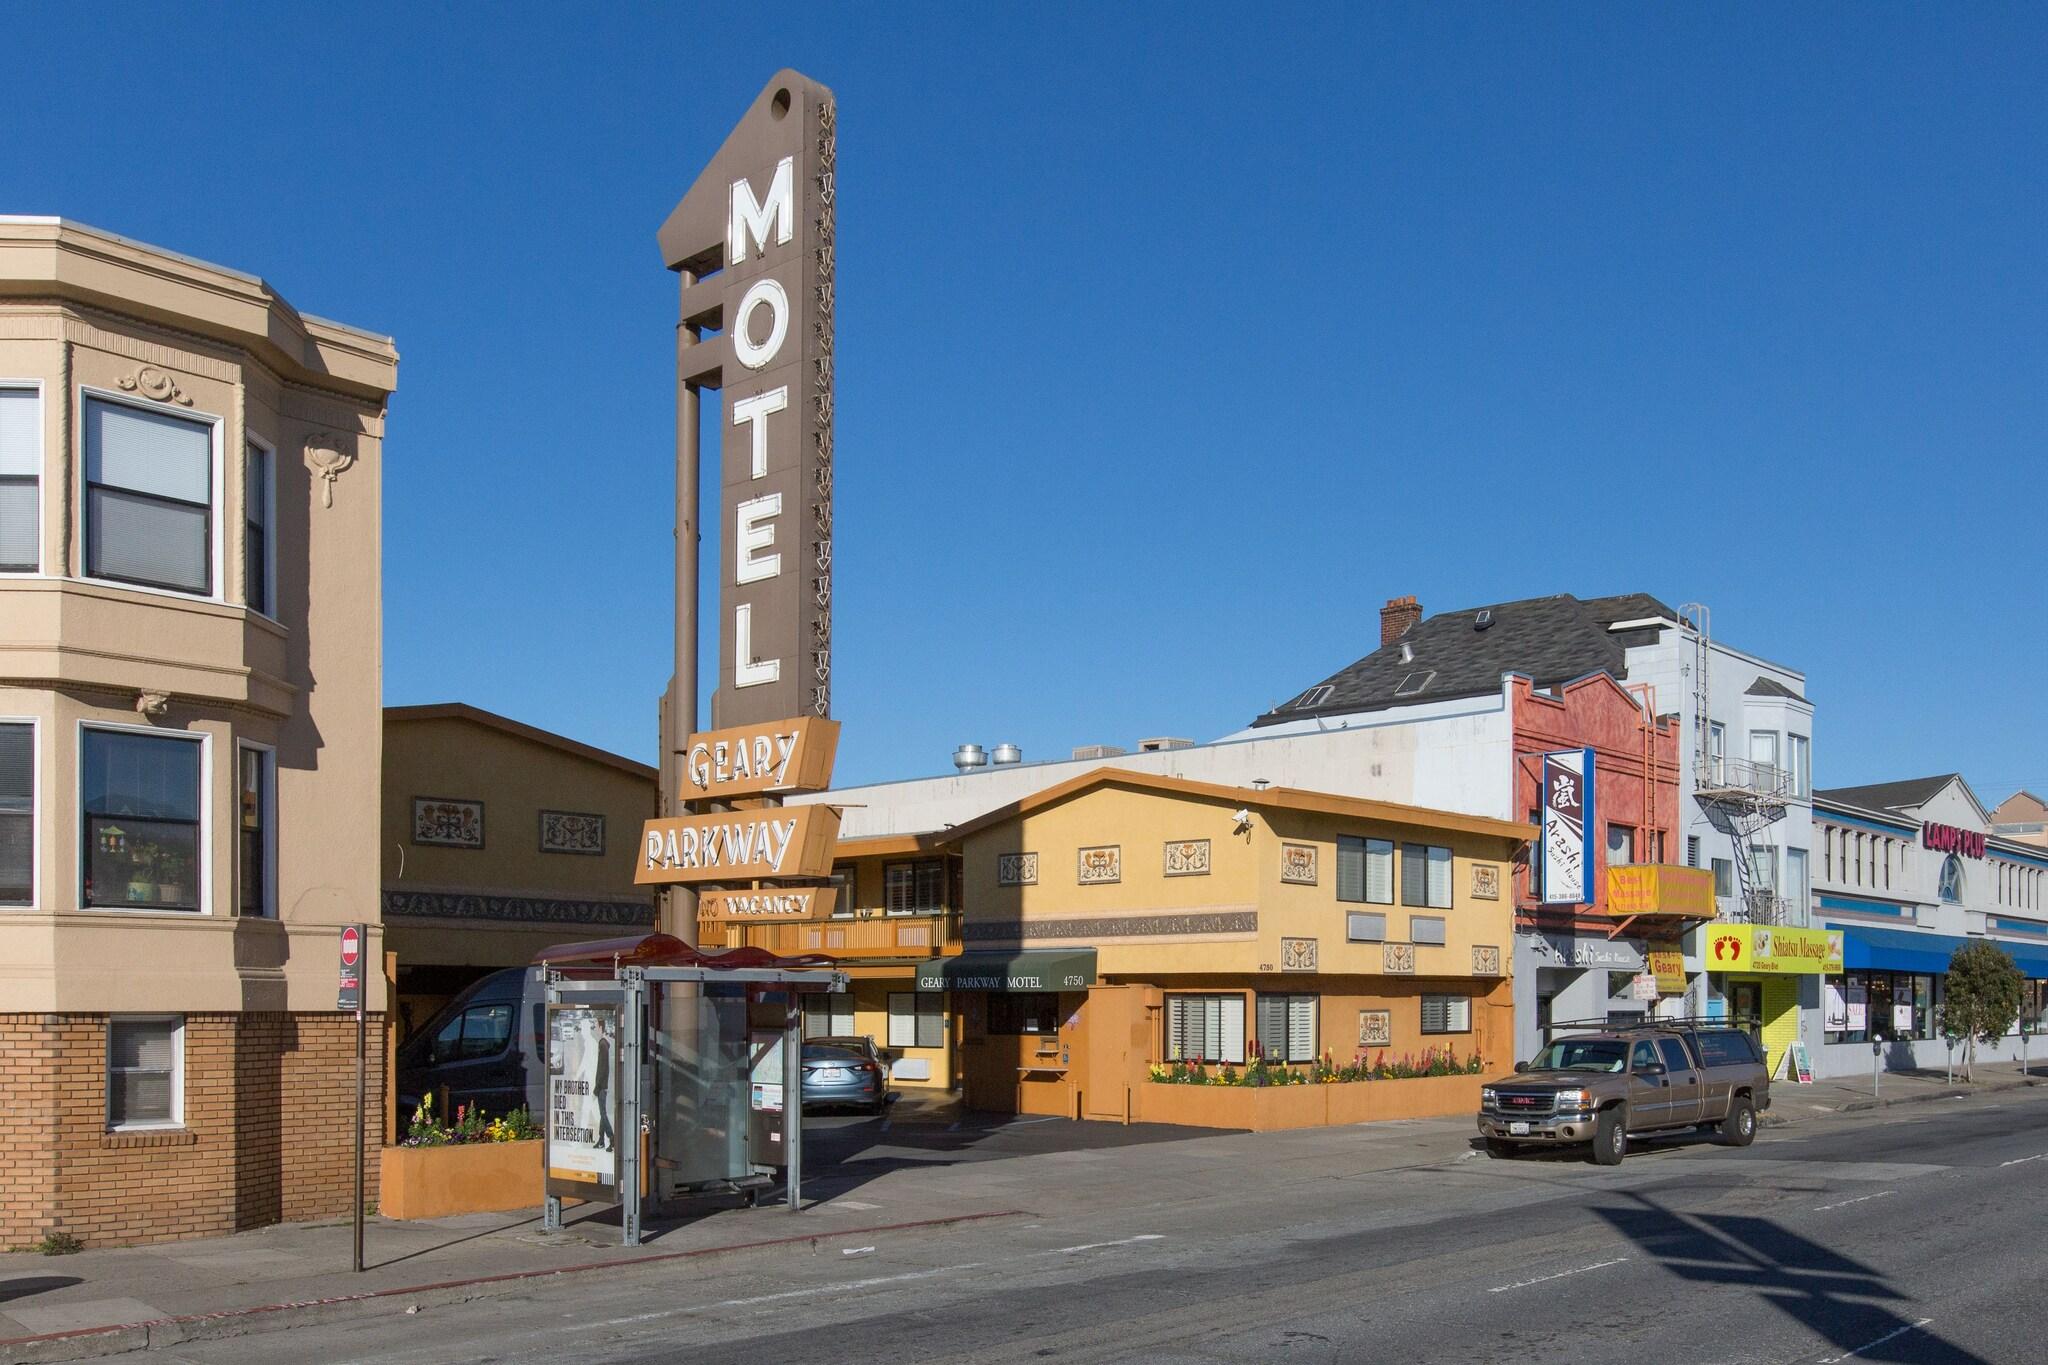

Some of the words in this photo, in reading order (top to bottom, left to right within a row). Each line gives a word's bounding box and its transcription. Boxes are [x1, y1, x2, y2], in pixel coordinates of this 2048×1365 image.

[730, 155, 794, 689] MOTEL
[689, 730, 800, 789] GEARY
[1552, 774, 1580, 809] 嵐
[647, 818, 797, 873] PARKWAY
[1547, 819, 1580, 870] Arashi
[1923, 821, 1961, 853] LAMPS
[1960, 829, 1985, 860] PLUS
[1565, 868, 1582, 890] House
[726, 894, 811, 915] VACANCY
[1773, 935, 1798, 958] Shiatsu
[1798, 937, 1826, 963] Massage
[1655, 959, 1681, 977] Geary
[920, 976, 951, 989] GEARY
[956, 977, 1001, 989] PARKWAY
[1007, 976, 1042, 989] MOTEL
[1063, 975, 1084, 987] 4750
[554, 1079, 563, 1095] MY
[563, 1080, 590, 1096] BROTHER
[554, 1094, 567, 1110] DIED
[554, 1110, 560, 1125] IN
[561, 1111, 575, 1126] THIS
[554, 1126, 595, 1143] INTERSECTION.
